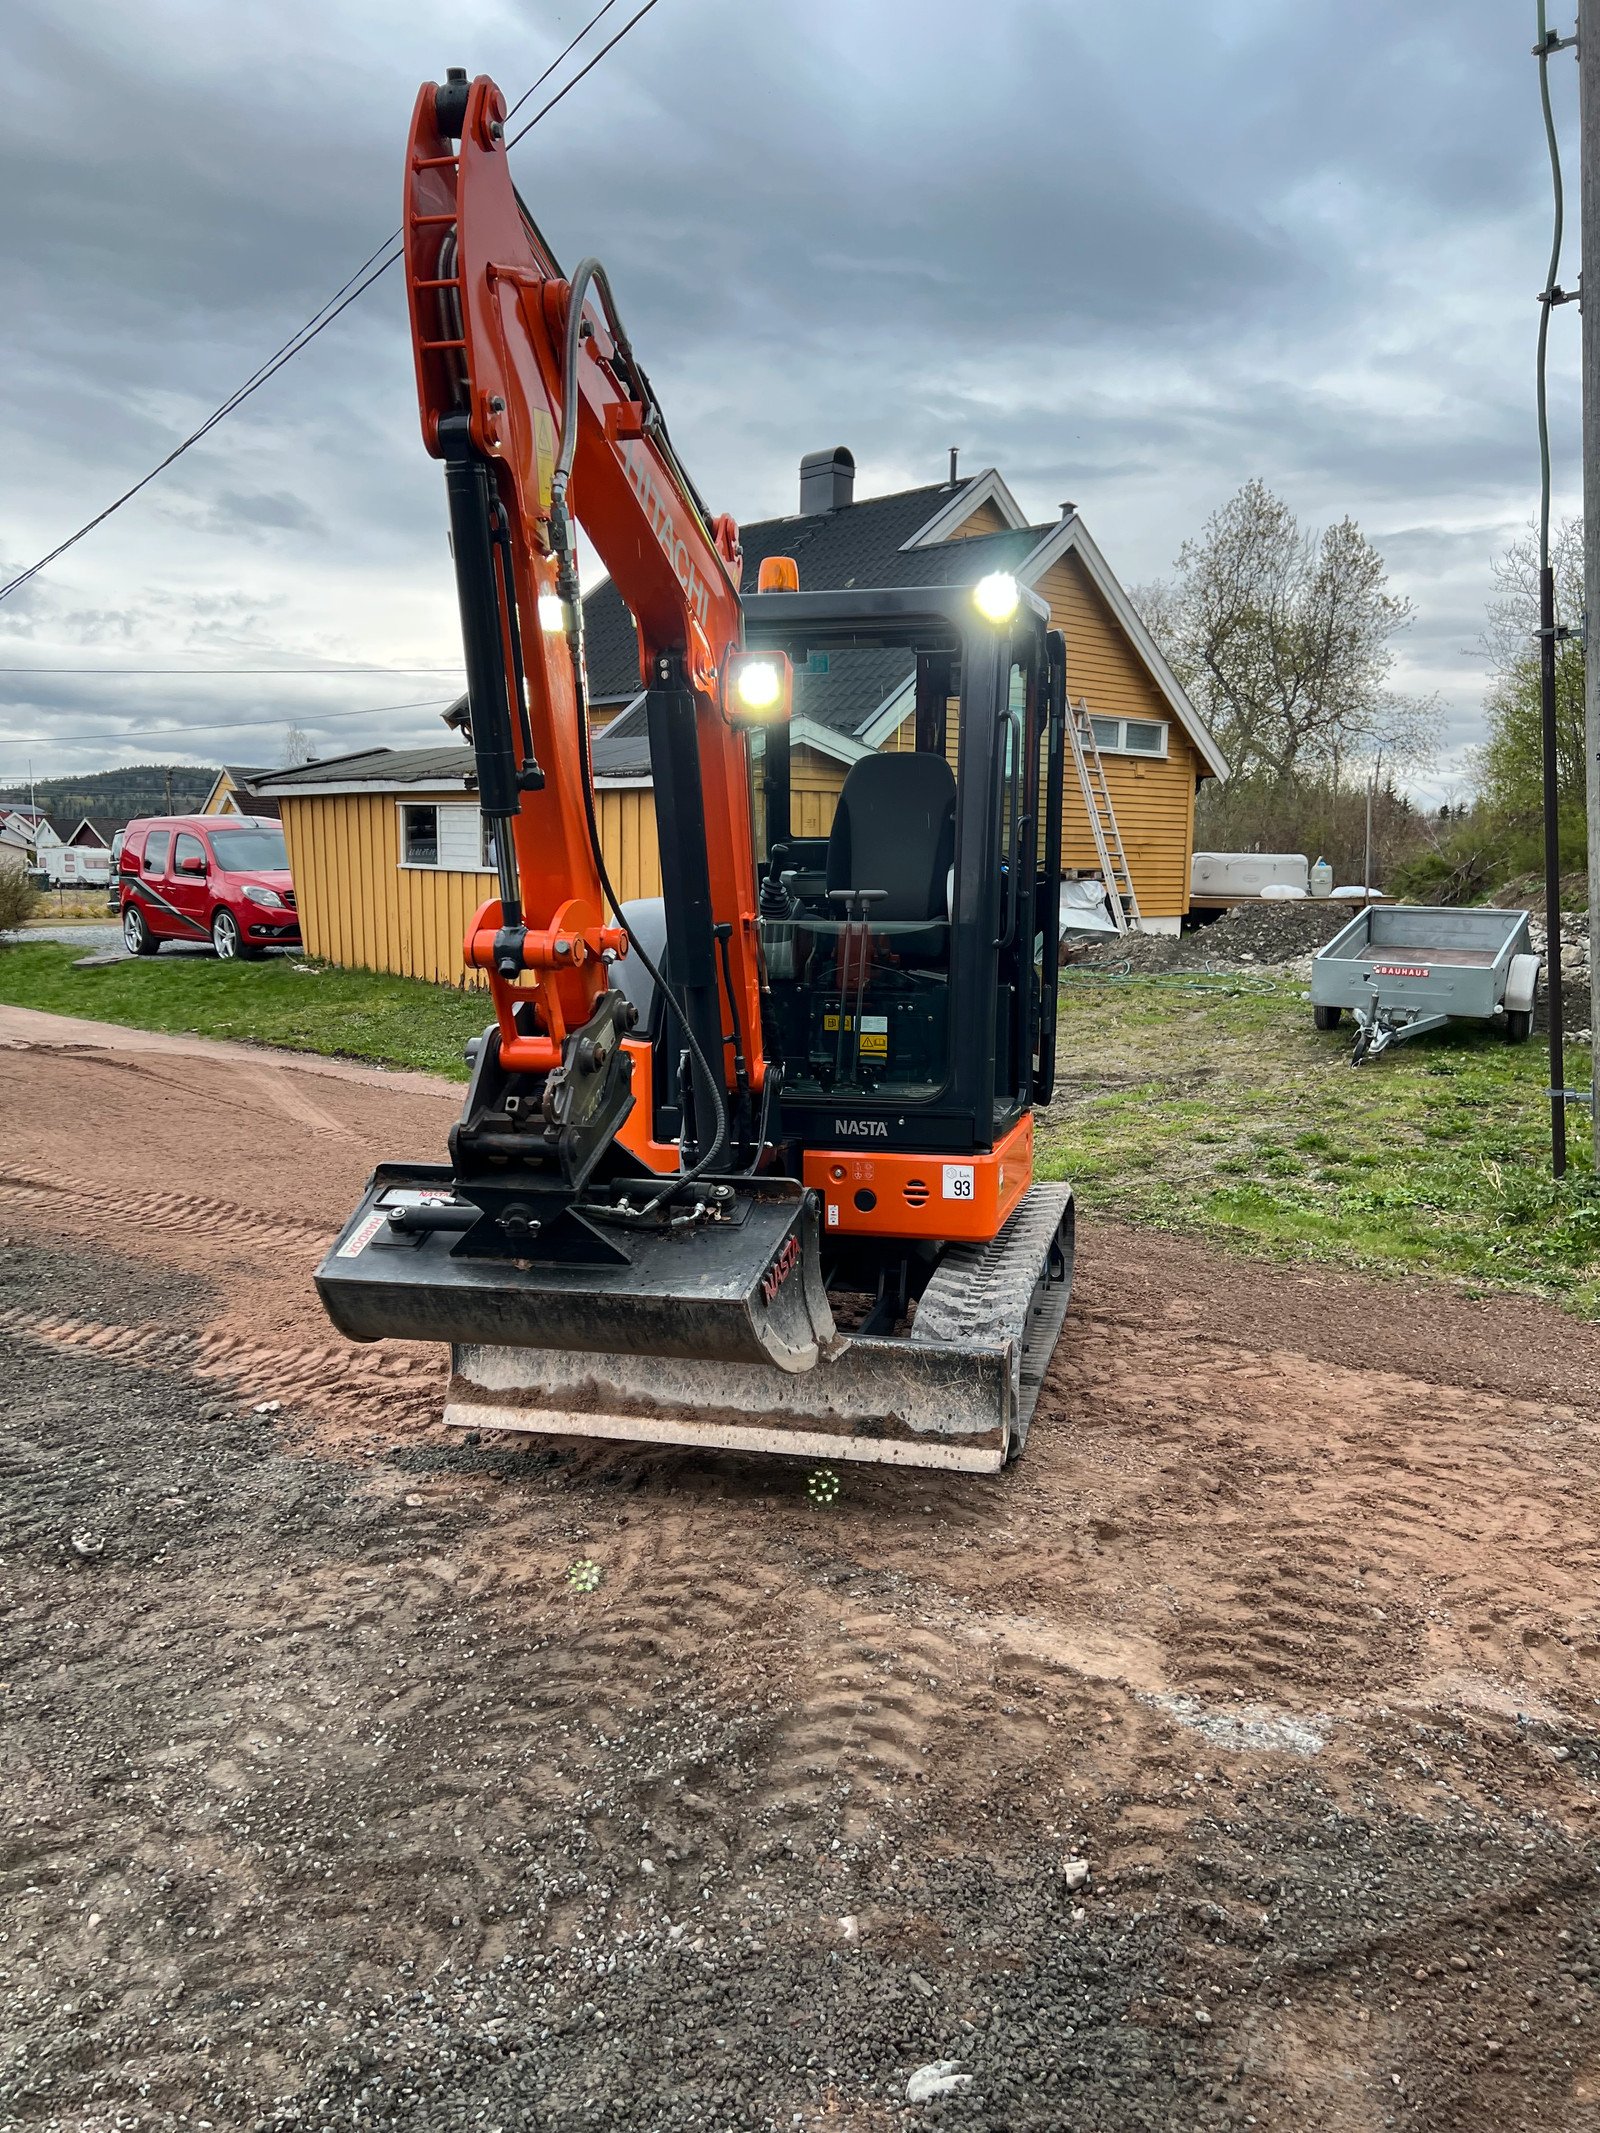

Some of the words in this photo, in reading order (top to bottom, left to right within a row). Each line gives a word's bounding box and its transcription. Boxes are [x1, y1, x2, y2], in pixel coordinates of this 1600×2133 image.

[623, 440, 709, 626] HITACHI
[1381, 967, 1429, 977] BAUHAUS
[835, 1119, 888, 1137] NASTA
[953, 1180, 971, 1196] 93
[347, 1217, 384, 1255] HARDOX
[761, 1234, 801, 1303] NASTA
